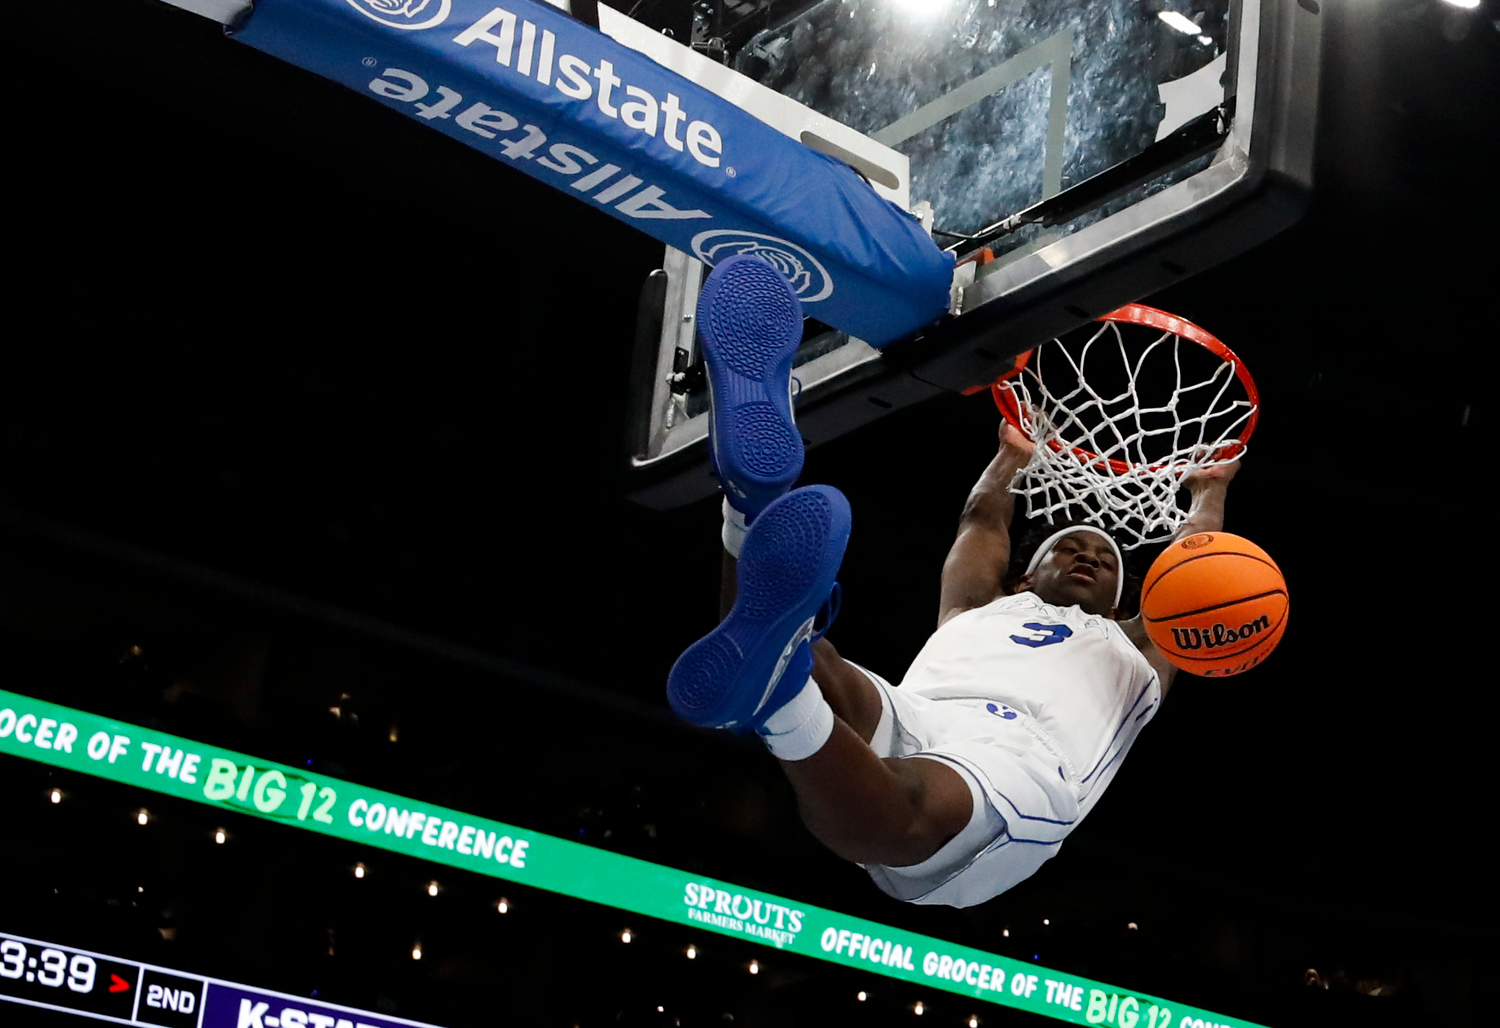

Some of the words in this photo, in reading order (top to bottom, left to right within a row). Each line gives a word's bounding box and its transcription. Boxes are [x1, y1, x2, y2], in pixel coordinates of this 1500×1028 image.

[452, 7, 723, 168] Allstate
[369, 68, 713, 219] Allstate
[1009, 622, 1073, 648] 3
[1171, 614, 1271, 650] Wilson
[0, 708, 78, 753] OCER
[87, 731, 130, 763] OF
[141, 741, 201, 784] THE
[203, 758, 287, 813] BIG
[297, 782, 337, 824] 12
[348, 798, 529, 869] CONFERENCE
[684, 881, 803, 933] SPROUTS
[688, 907, 743, 932] FARMERS
[745, 922, 796, 945] MARKET
[821, 927, 915, 971] OFFICIAL
[923, 951, 1006, 992] GROCER
[1010, 973, 1038, 998] OF
[1045, 979, 1084, 1011] THE
[146, 984, 196, 1014] 2ND
